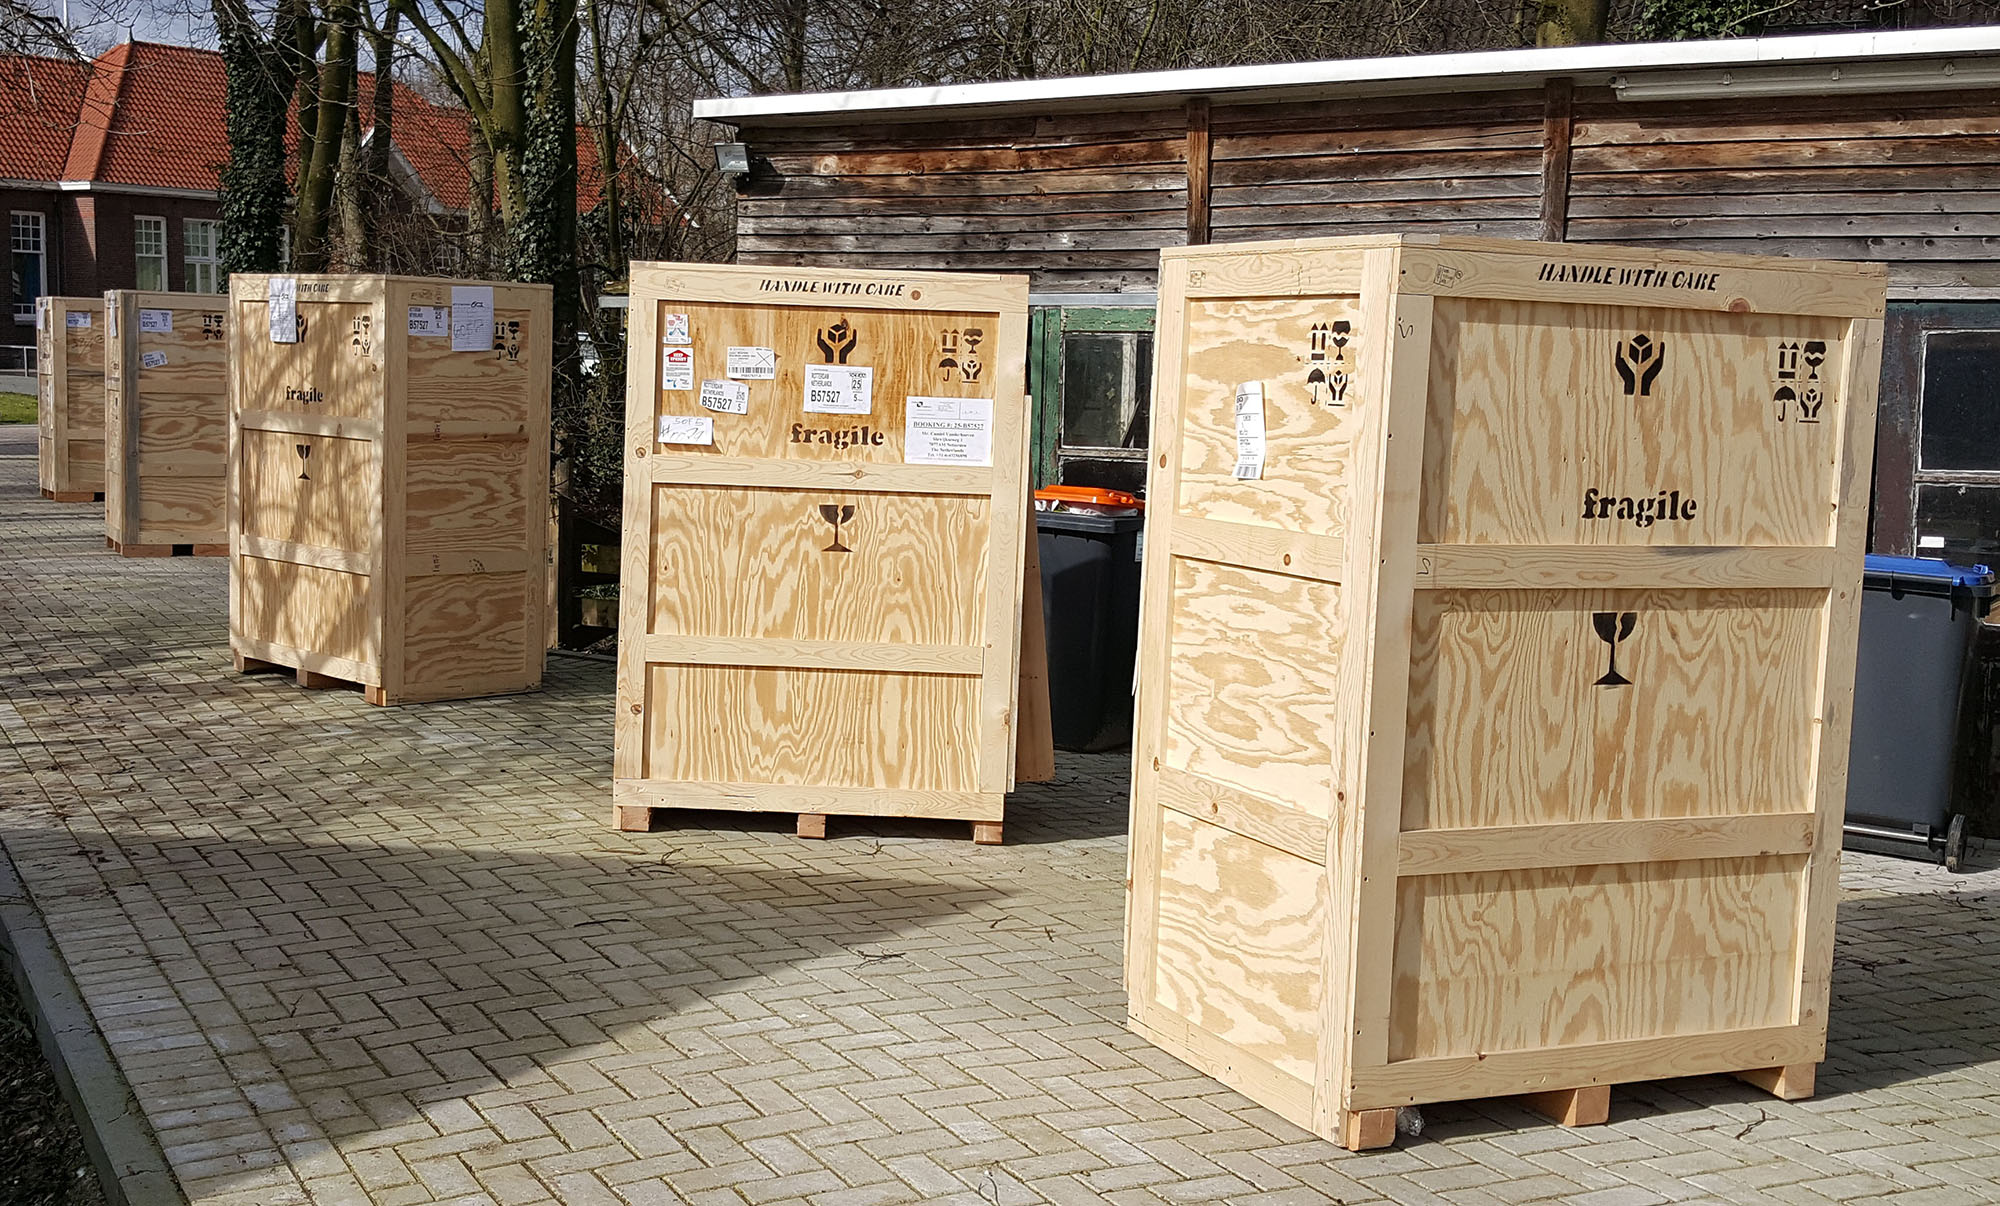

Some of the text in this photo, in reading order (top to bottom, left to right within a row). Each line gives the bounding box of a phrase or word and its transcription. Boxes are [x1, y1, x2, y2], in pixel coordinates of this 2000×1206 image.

[1538, 263, 1720, 291] HANDLE WITH CARE
[313, 283, 329, 293] CARE
[759, 279, 905, 296] HANDLE WITH CARE
[852, 379, 862, 389] 25
[286, 385, 323, 405] fragile
[701, 395, 732, 411] B57527
[811, 389, 840, 402] B57527
[913, 421, 946, 429] BOOKING
[790, 422, 884, 450] fragile
[1582, 488, 1697, 528] fragile
